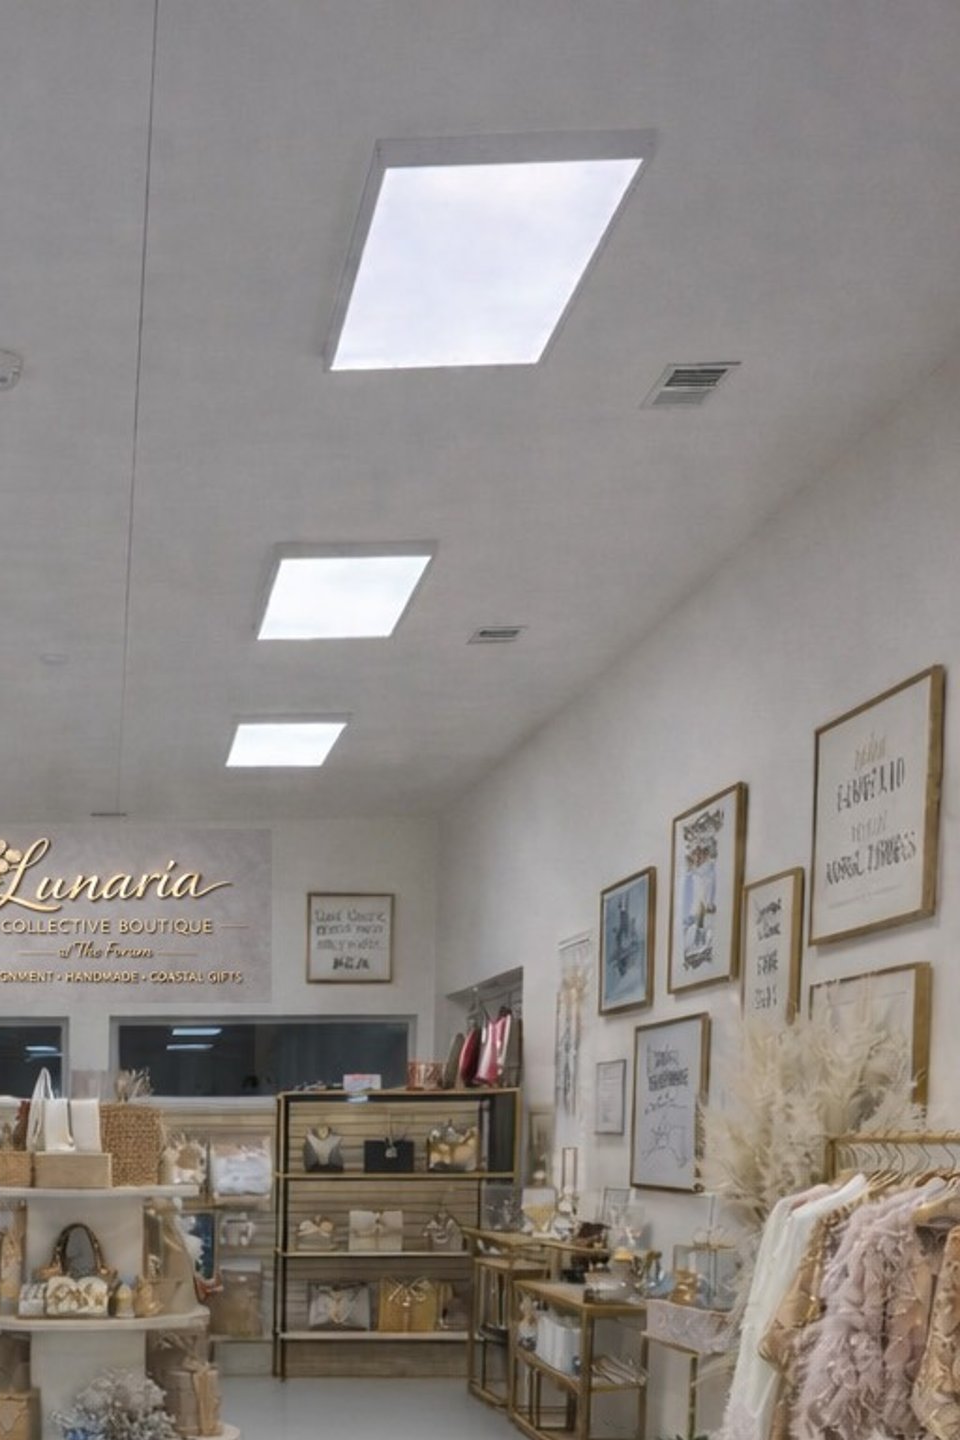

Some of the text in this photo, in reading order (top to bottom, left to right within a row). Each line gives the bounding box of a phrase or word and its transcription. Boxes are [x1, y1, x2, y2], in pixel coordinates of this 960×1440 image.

[0, 918, 213, 935] COLLECTIVE BOUTIQUE
[105, 942, 154, 959] Forum
[65, 971, 139, 984] HANDMADE
[149, 971, 204, 984] COASTAL
[208, 971, 243, 984] GIFTS
